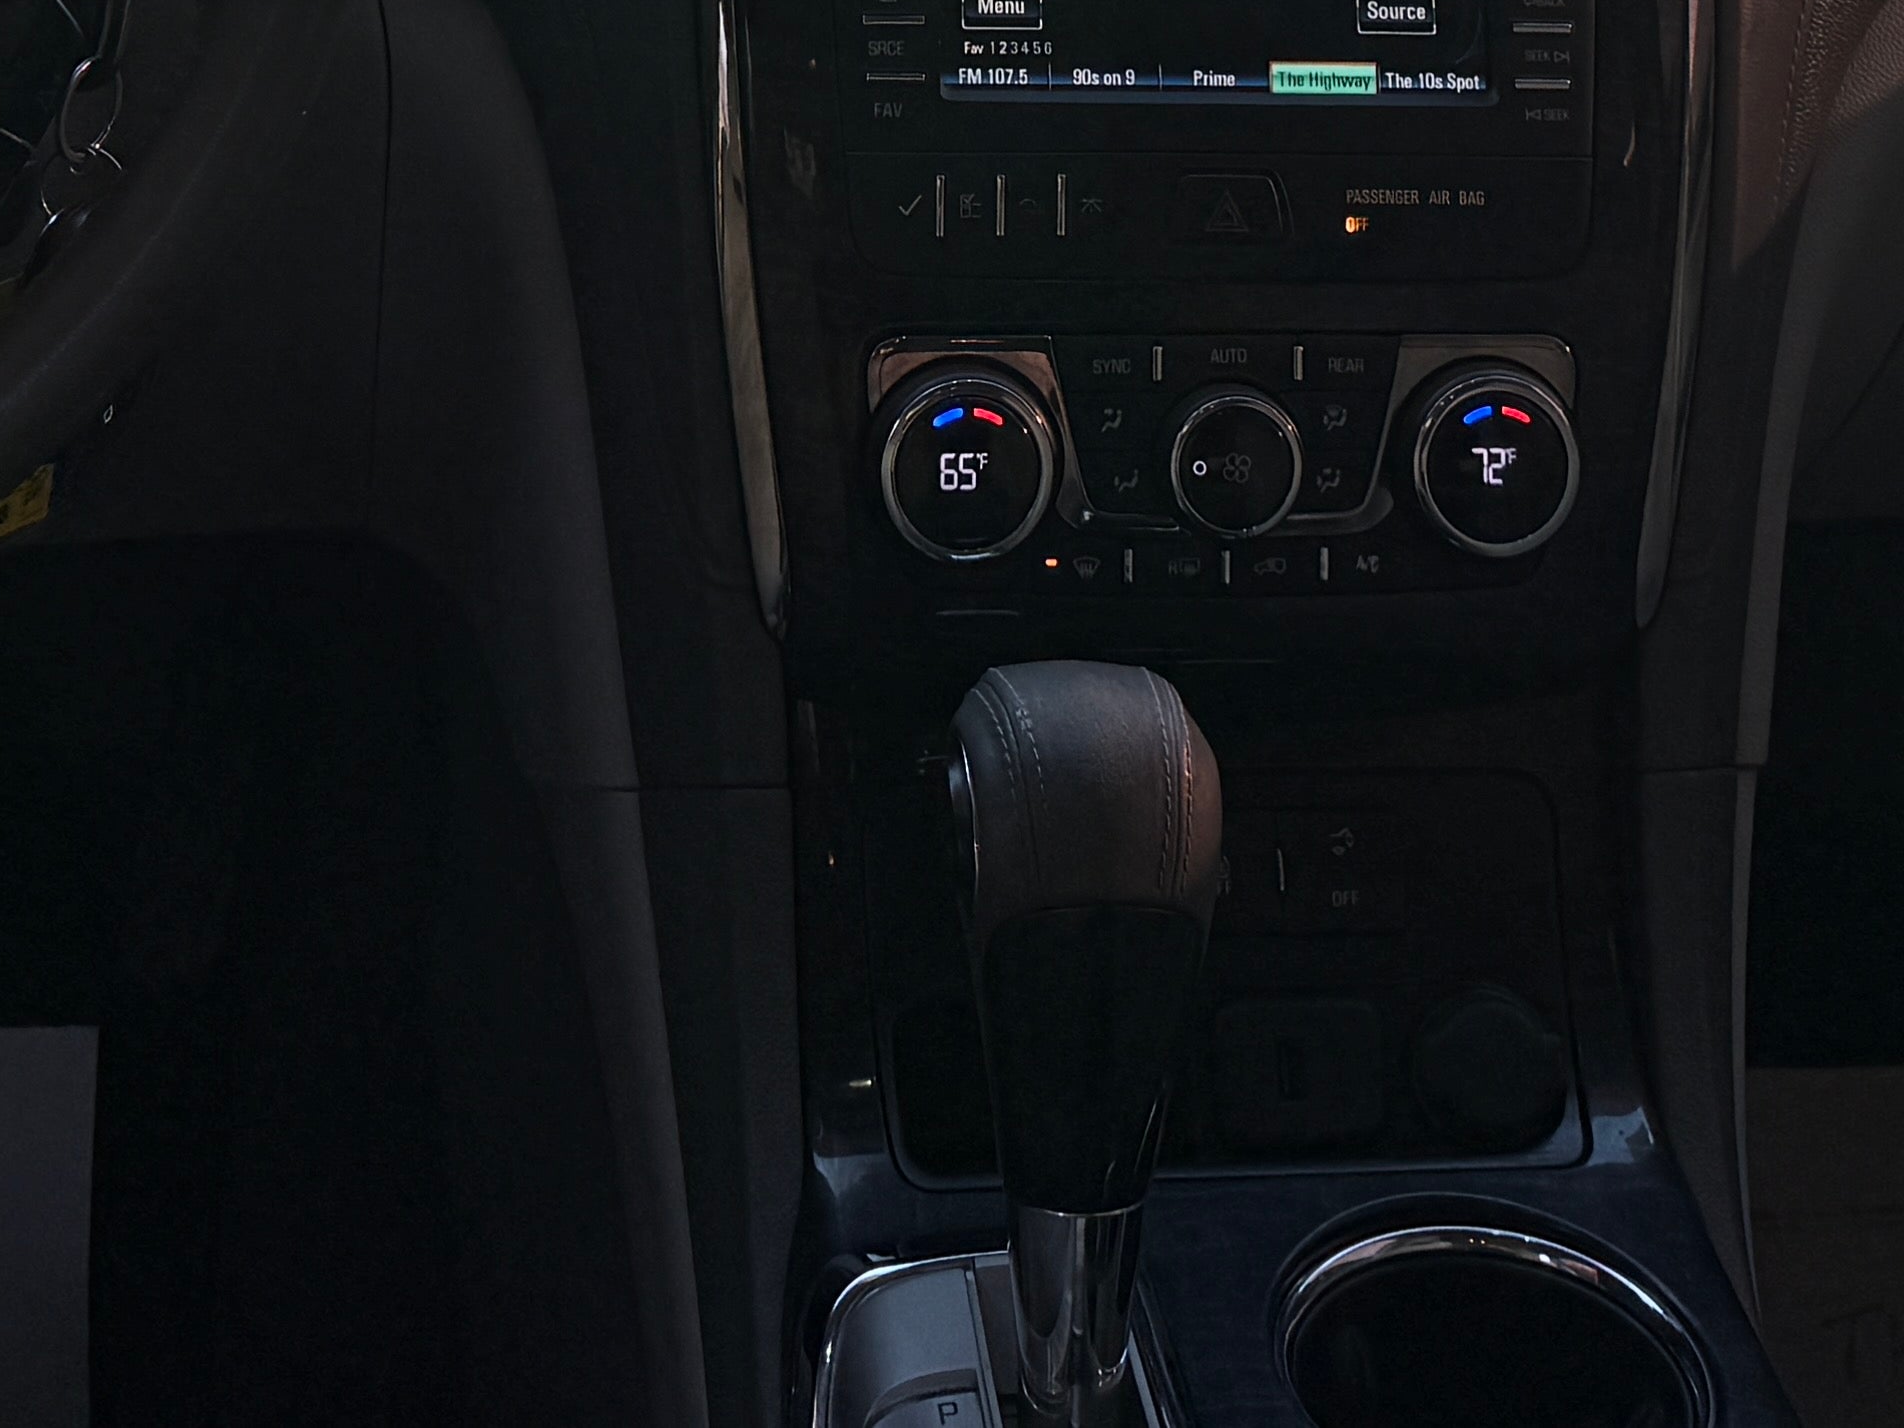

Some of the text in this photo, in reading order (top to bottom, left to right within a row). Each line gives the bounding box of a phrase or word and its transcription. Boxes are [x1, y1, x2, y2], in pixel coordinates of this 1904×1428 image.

[1366, 0, 1427, 21] Source
[964, 41, 984, 55] Fav
[999, 41, 1008, 55] 2
[1010, 41, 1019, 55] 3
[1021, 41, 1030, 55] 4
[1033, 41, 1041, 55] 5
[1044, 41, 1053, 55] 6
[958, 68, 1029, 85] FM 107.5
[1072, 69, 1136, 86] 90s on 9
[1193, 69, 1236, 87] Prime
[1277, 71, 1372, 92] The Highway
[1384, 72, 1481, 93] The 10s Spot
[873, 102, 903, 119] FAV
[1346, 188, 1486, 206] PASSENGER AIR BAG
[1345, 216, 1370, 234] OFF
[1210, 347, 1248, 364] AUTO
[1092, 357, 1132, 375] SYNC
[1328, 357, 1365, 374] REAR
[1332, 890, 1360, 907] OFF
[937, 1401, 959, 1426] P
